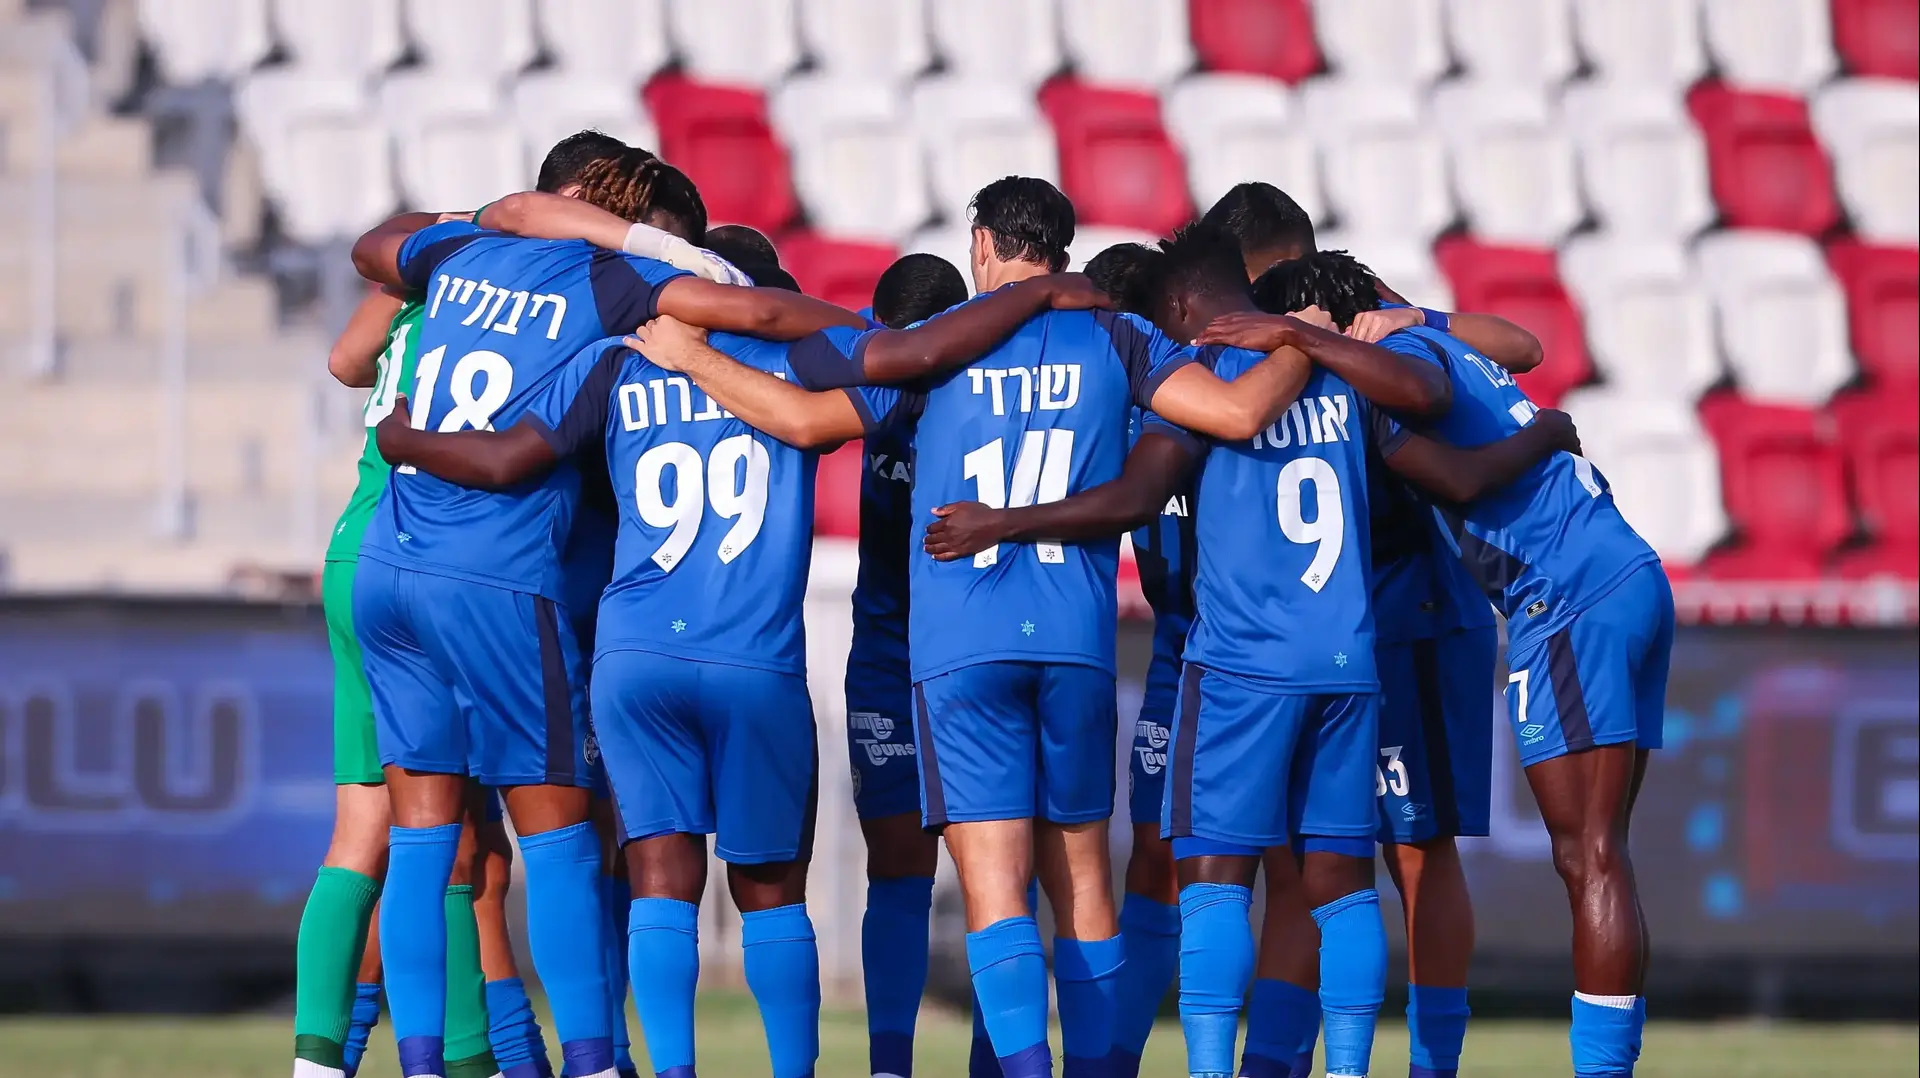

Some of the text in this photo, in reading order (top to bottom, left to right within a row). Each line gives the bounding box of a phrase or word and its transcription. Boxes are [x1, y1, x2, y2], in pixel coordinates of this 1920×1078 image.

[397, 344, 514, 475] 18
[635, 434, 771, 573] 99
[1277, 457, 1345, 593] 9
[855, 738, 917, 766] TOURS
[1134, 746, 1168, 774] TOU
[1523, 735, 1545, 746] umbro
